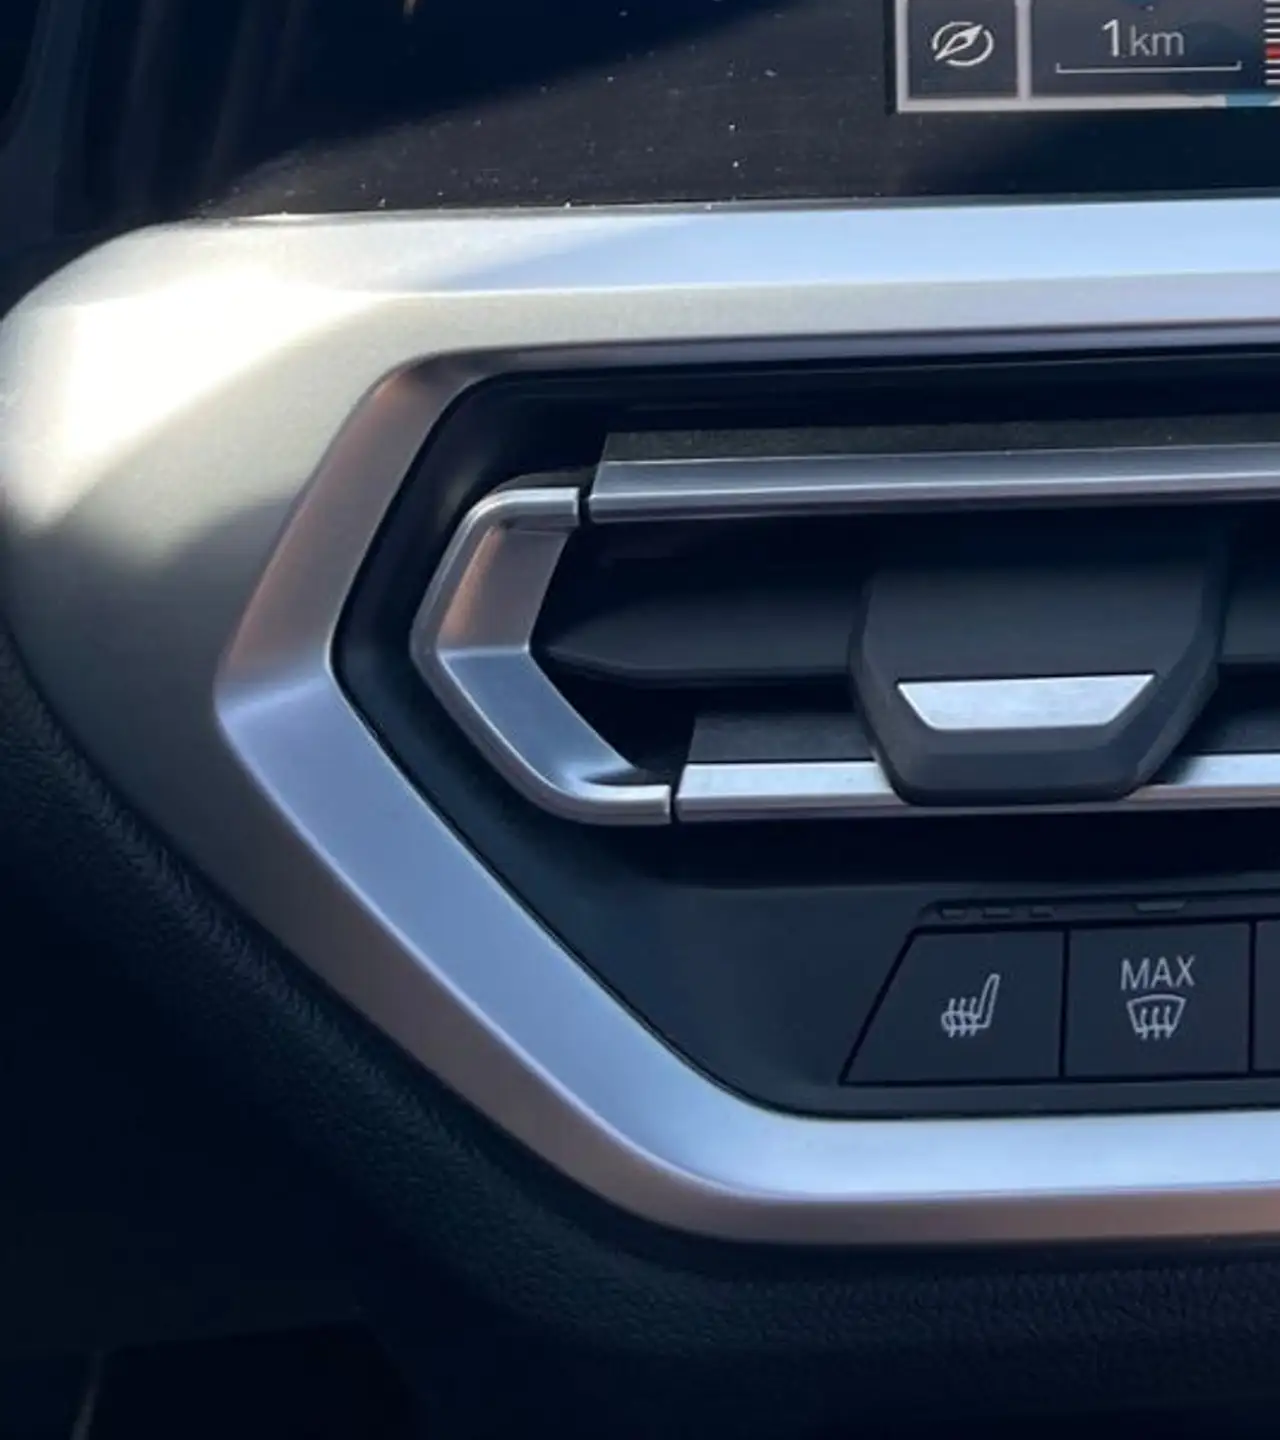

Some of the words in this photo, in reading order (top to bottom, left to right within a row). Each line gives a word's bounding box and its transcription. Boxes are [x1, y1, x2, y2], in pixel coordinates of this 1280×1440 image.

[1101, 17, 1120, 58] 1
[1130, 24, 1185, 57] km
[1119, 955, 1196, 991] MAX
